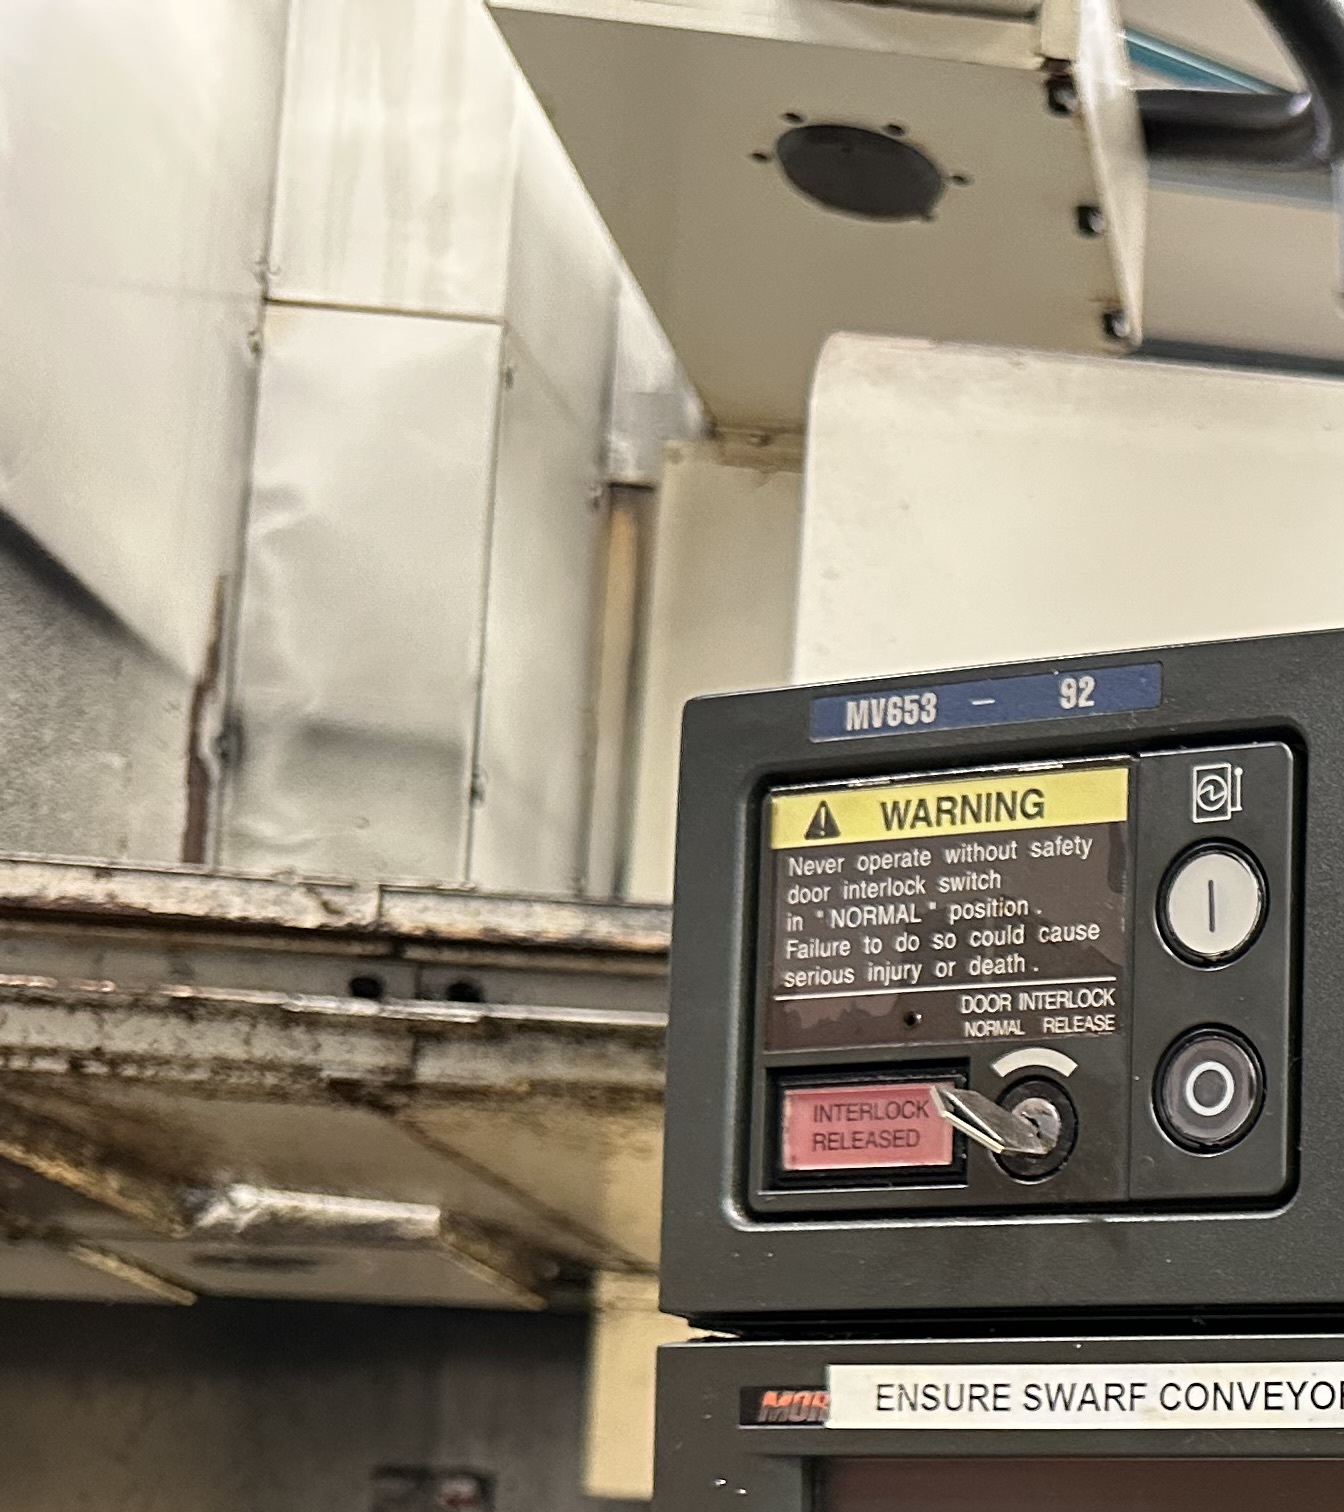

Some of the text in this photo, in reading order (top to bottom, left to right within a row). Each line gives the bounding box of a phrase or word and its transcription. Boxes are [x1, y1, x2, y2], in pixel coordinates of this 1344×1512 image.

[846, 693, 937, 732] MV653
[1059, 678, 1095, 709] 92
[880, 789, 1045, 831] WARNING
[789, 836, 1093, 876] Never operate without safety
[788, 872, 1001, 905] door interlock switch
[787, 911, 803, 931] in
[786, 923, 1100, 959] Failure to do so could cause
[784, 963, 855, 988] serious
[867, 959, 922, 985] injury
[935, 961, 955, 978] or
[961, 989, 1115, 1013] DOOR INTERLOCK
[964, 1016, 1115, 1037] NORMAL RELEASE
[812, 1101, 929, 1122] INTERLOCK
[812, 1129, 920, 1151] RELEASED
[876, 1383, 1012, 1412] ENSURE
[1023, 1383, 1147, 1412] SWARF
